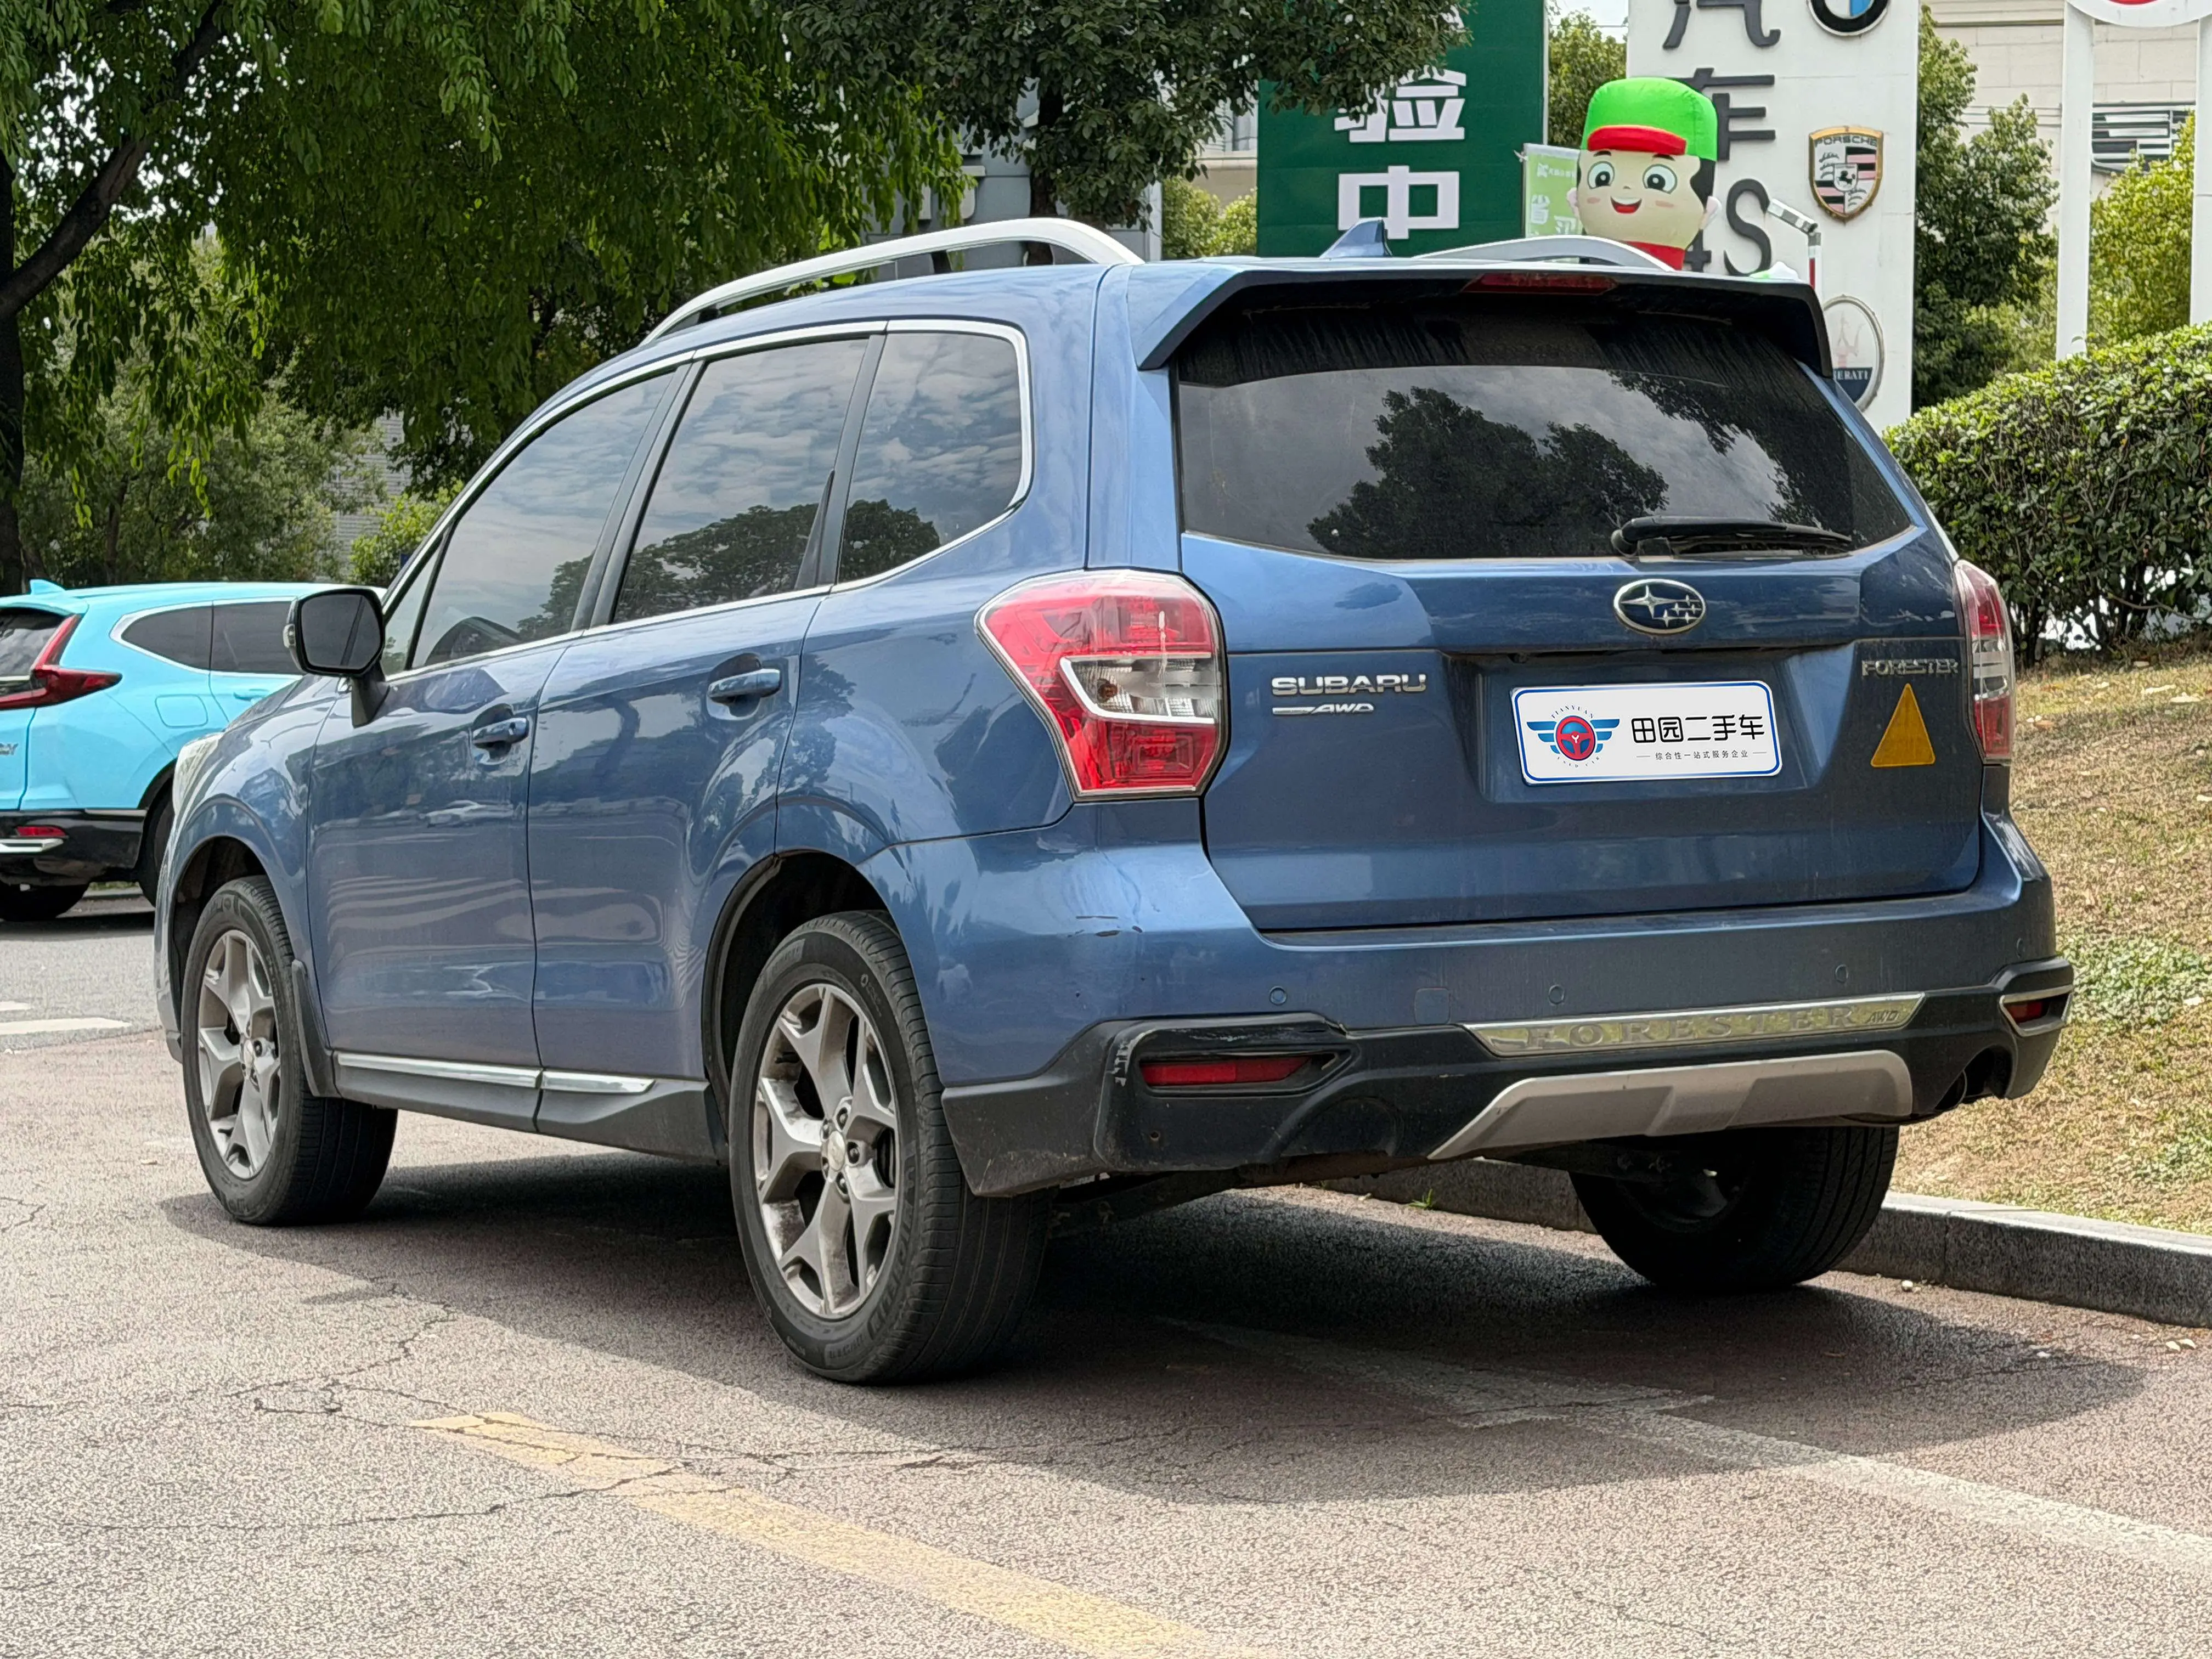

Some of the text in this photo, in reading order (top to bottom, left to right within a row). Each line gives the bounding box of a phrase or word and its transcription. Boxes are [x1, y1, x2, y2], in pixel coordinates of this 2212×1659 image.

[1815, 135, 1877, 147] PORSCHE
[1833, 370, 1868, 380] ERATI
[1862, 659, 1959, 676] FORESTER
[1271, 674, 1426, 696] SUBARU
[1311, 703, 1374, 714] AWD
[1631, 714, 1765, 743] 田园二手车
[1655, 749, 1748, 760] 综合性一站式服务企业
[1528, 1007, 1900, 1050] FORESTER AWD
